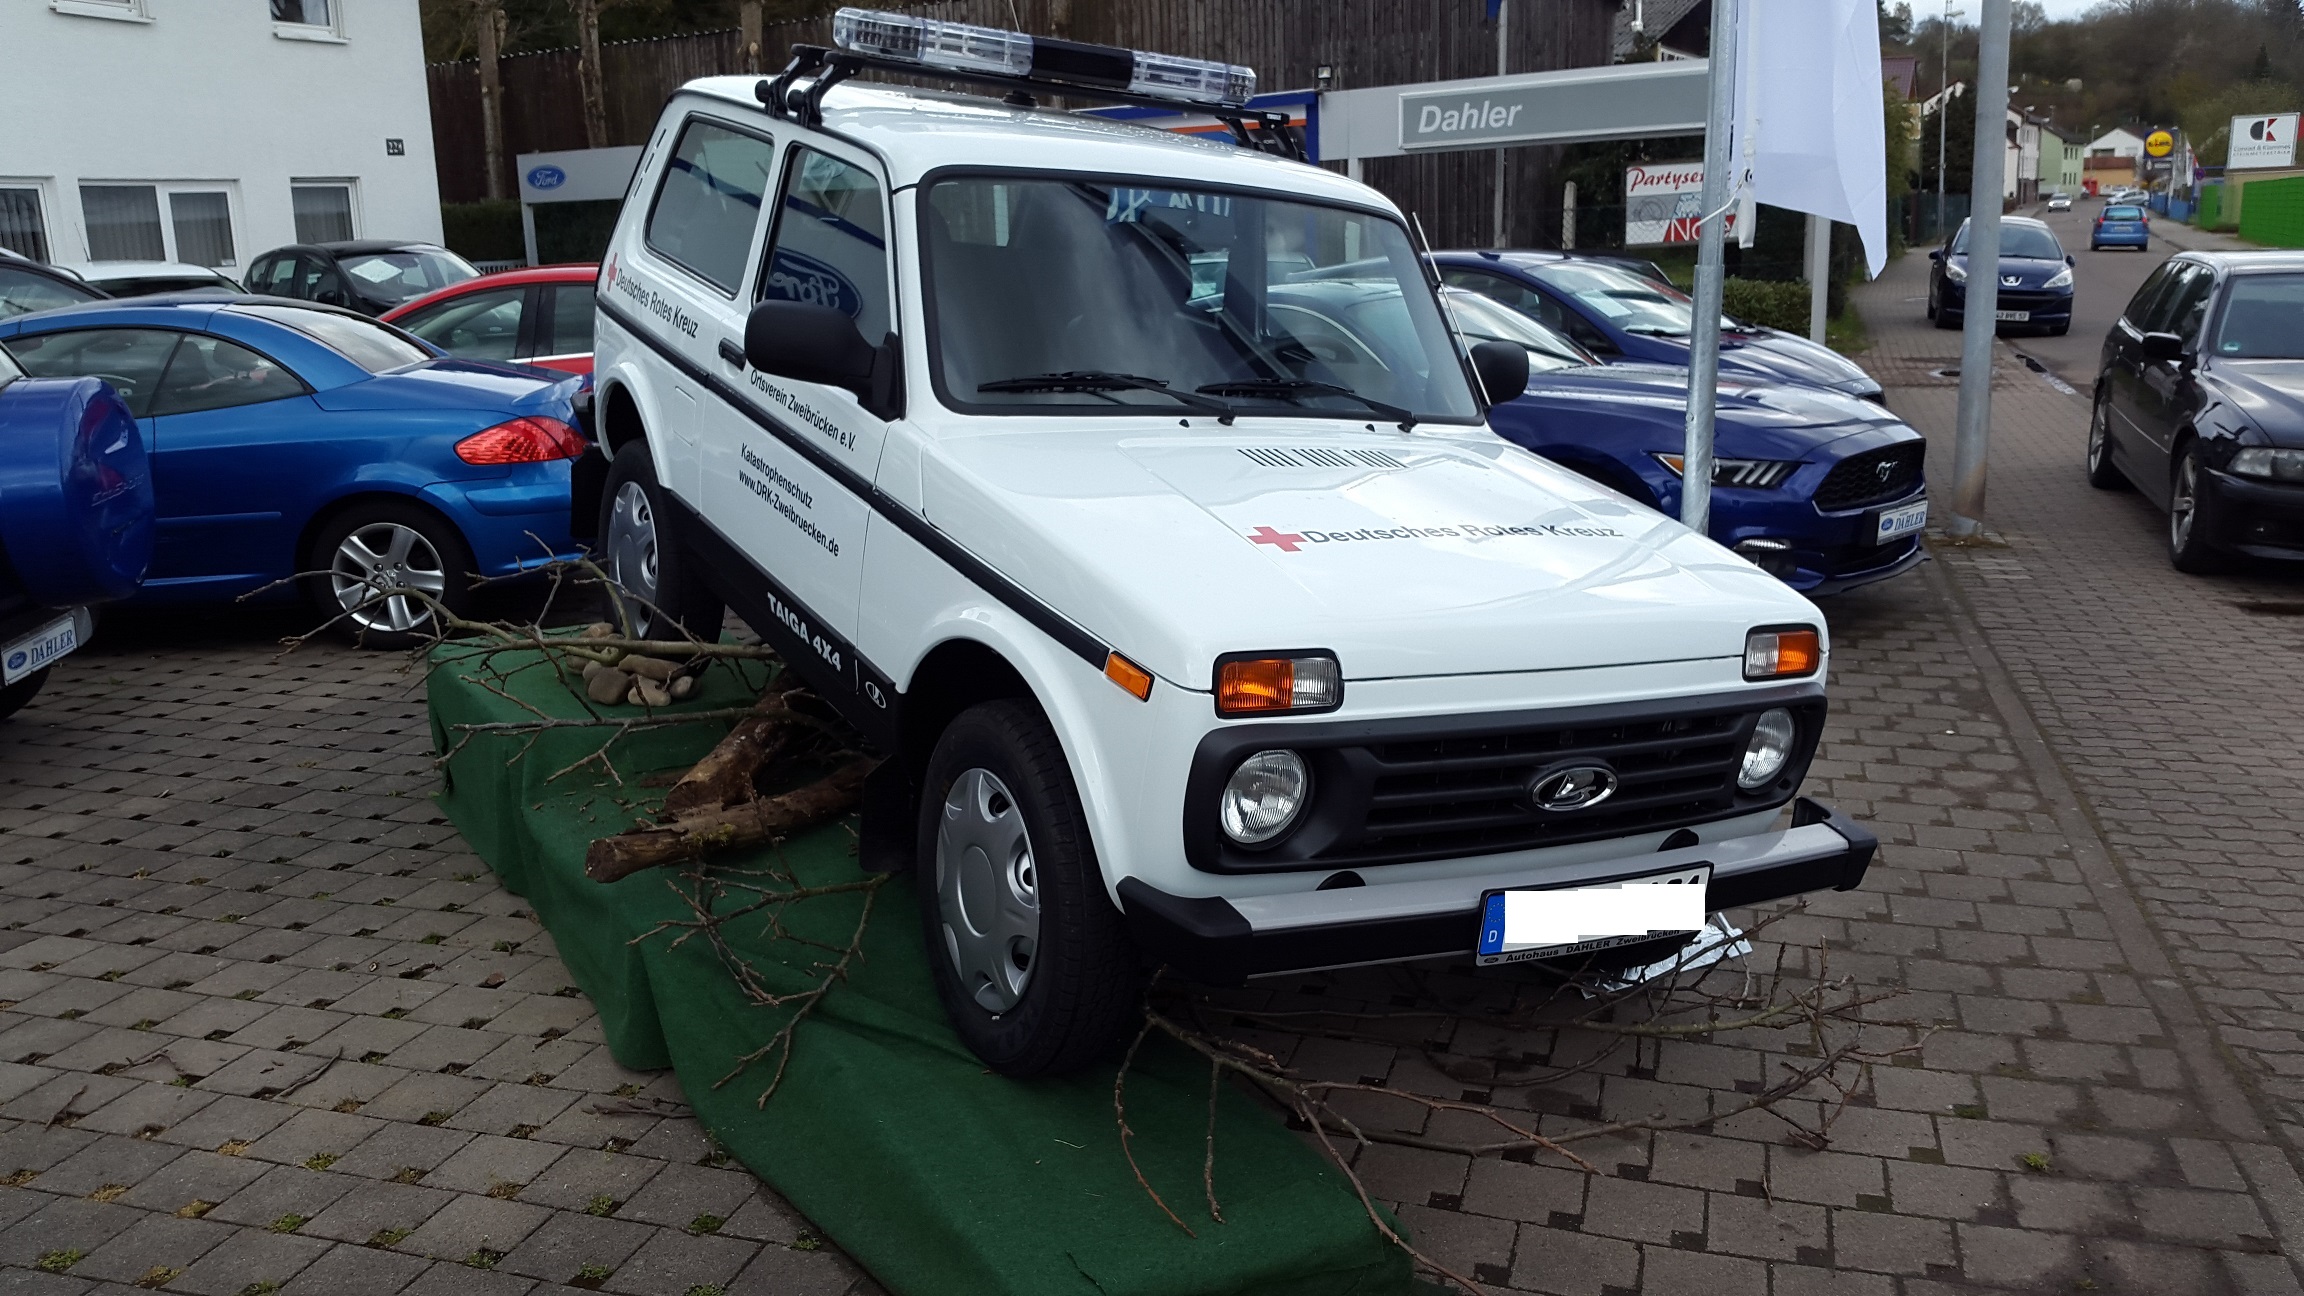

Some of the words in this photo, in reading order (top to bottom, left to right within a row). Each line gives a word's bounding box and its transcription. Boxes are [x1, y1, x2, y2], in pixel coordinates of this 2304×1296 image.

[1418, 100, 1523, 133] Dahler
[534, 170, 559, 187] Ford
[616, 268, 650, 308] Deutsches
[649, 290, 673, 323] Rotes
[672, 305, 699, 339] Kreuz
[750, 369, 788, 407] Ortsverein
[787, 394, 839, 441] Zweibrücken
[840, 431, 857, 452] e.V.
[741, 443, 813, 510] Katastrophenschutz
[739, 469, 840, 557] www.DRK-Zweibruecken.de
[1894, 511, 1926, 531] DAHLER
[1300, 525, 1460, 544] Deutsches
[1458, 524, 1544, 537] Rotes
[1539, 524, 1624, 537] Kreuz
[767, 591, 810, 645] TAIGA
[31, 629, 73, 665] DAHLER
[1488, 930, 1498, 943] D
[1506, 949, 1559, 962] Autohaus
[1566, 940, 1611, 954] DAHLER
[1616, 930, 1680, 946] Zweibrücken
